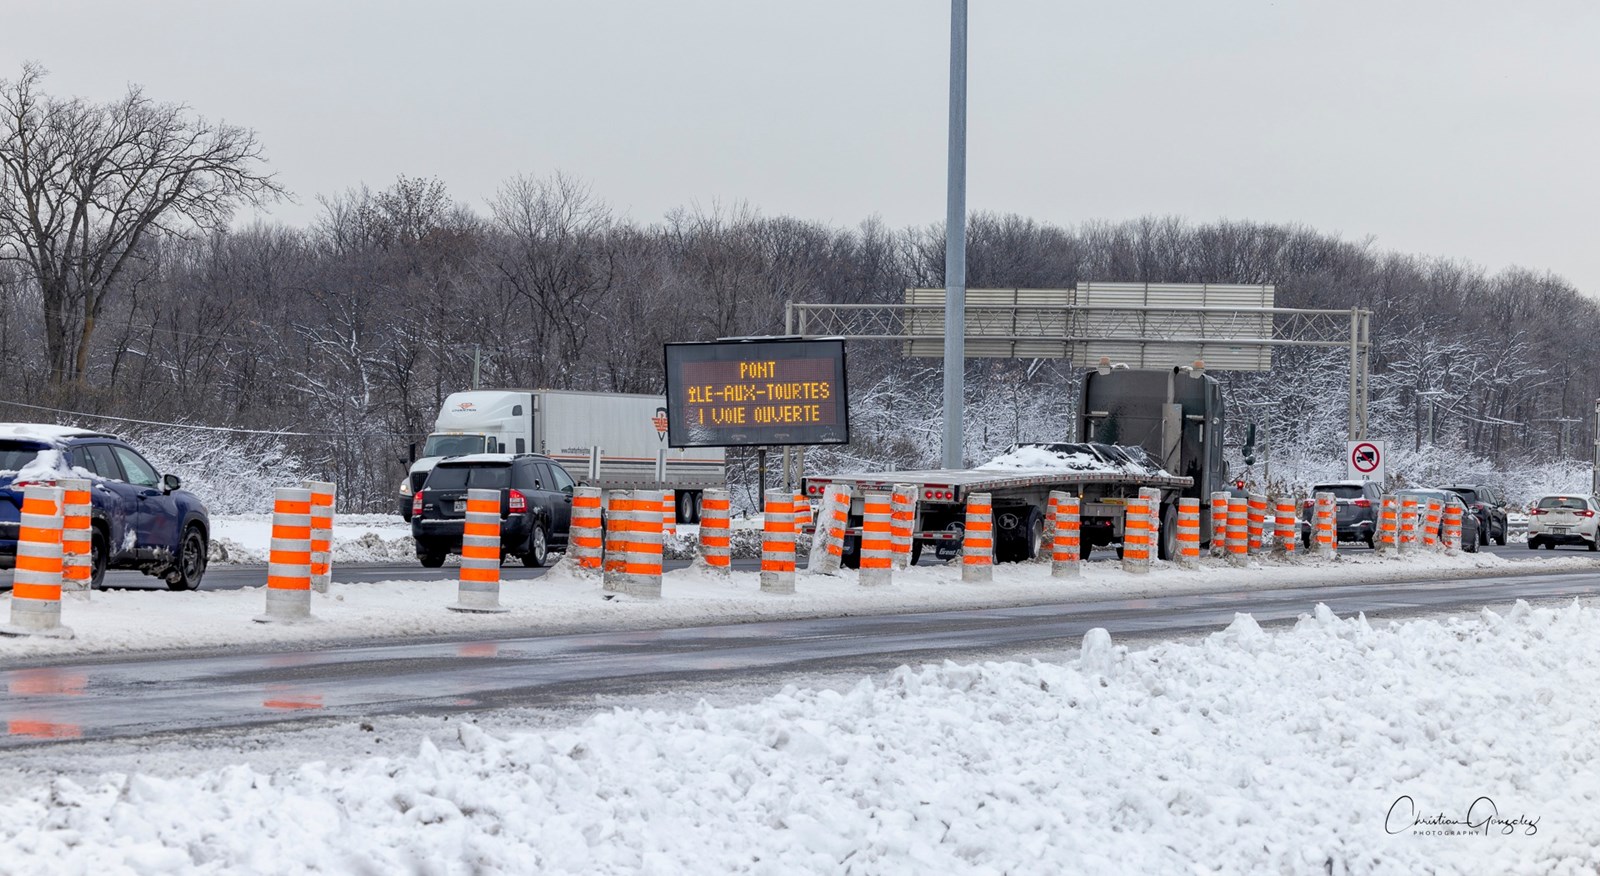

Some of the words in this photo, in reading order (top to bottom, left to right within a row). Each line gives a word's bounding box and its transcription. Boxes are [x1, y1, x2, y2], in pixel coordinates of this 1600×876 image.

[740, 361, 776, 378] PONT
[712, 407, 746, 424] VOIE
[754, 405, 820, 423] OUVERTE
[939, 547, 956, 556] Great
